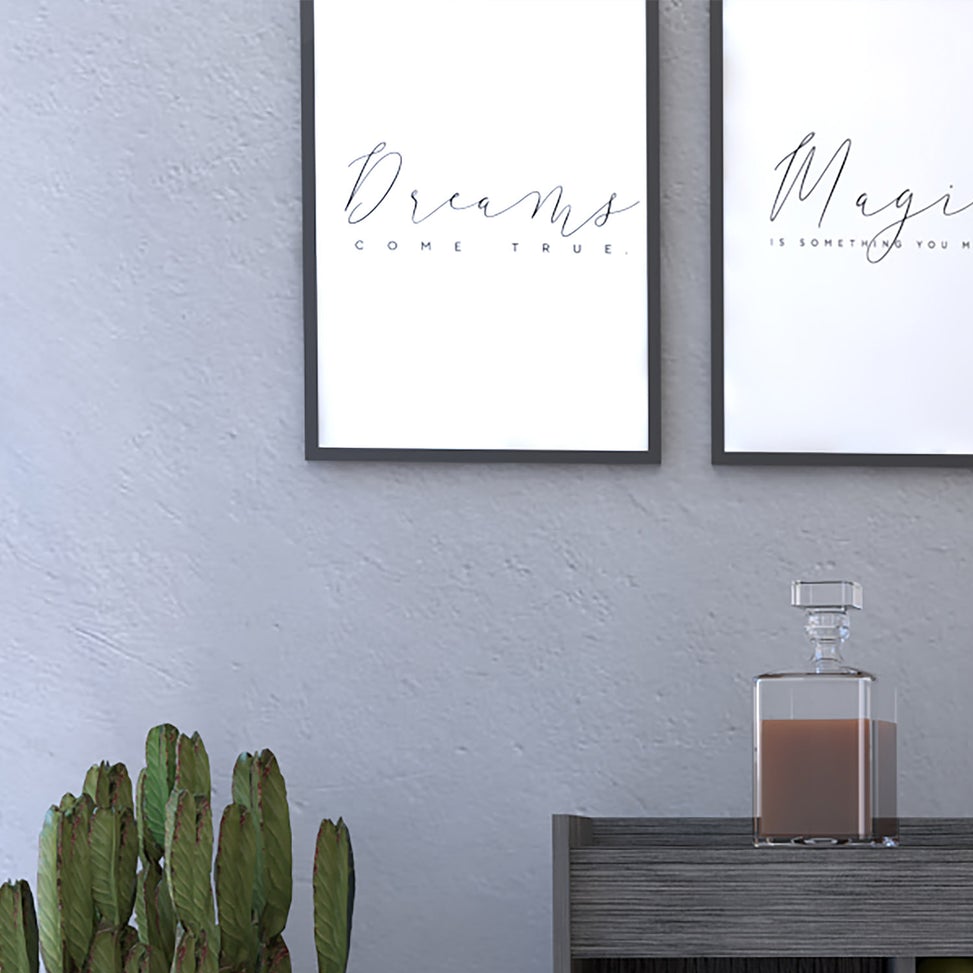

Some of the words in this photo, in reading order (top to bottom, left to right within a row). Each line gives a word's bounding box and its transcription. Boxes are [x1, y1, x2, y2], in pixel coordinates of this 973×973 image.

[344, 141, 640, 237] Dreams
[354, 239, 462, 252] COME
[769, 237, 785, 247] IS
[799, 238, 903, 249] SOMETHING
[916, 240, 948, 249] YOU
